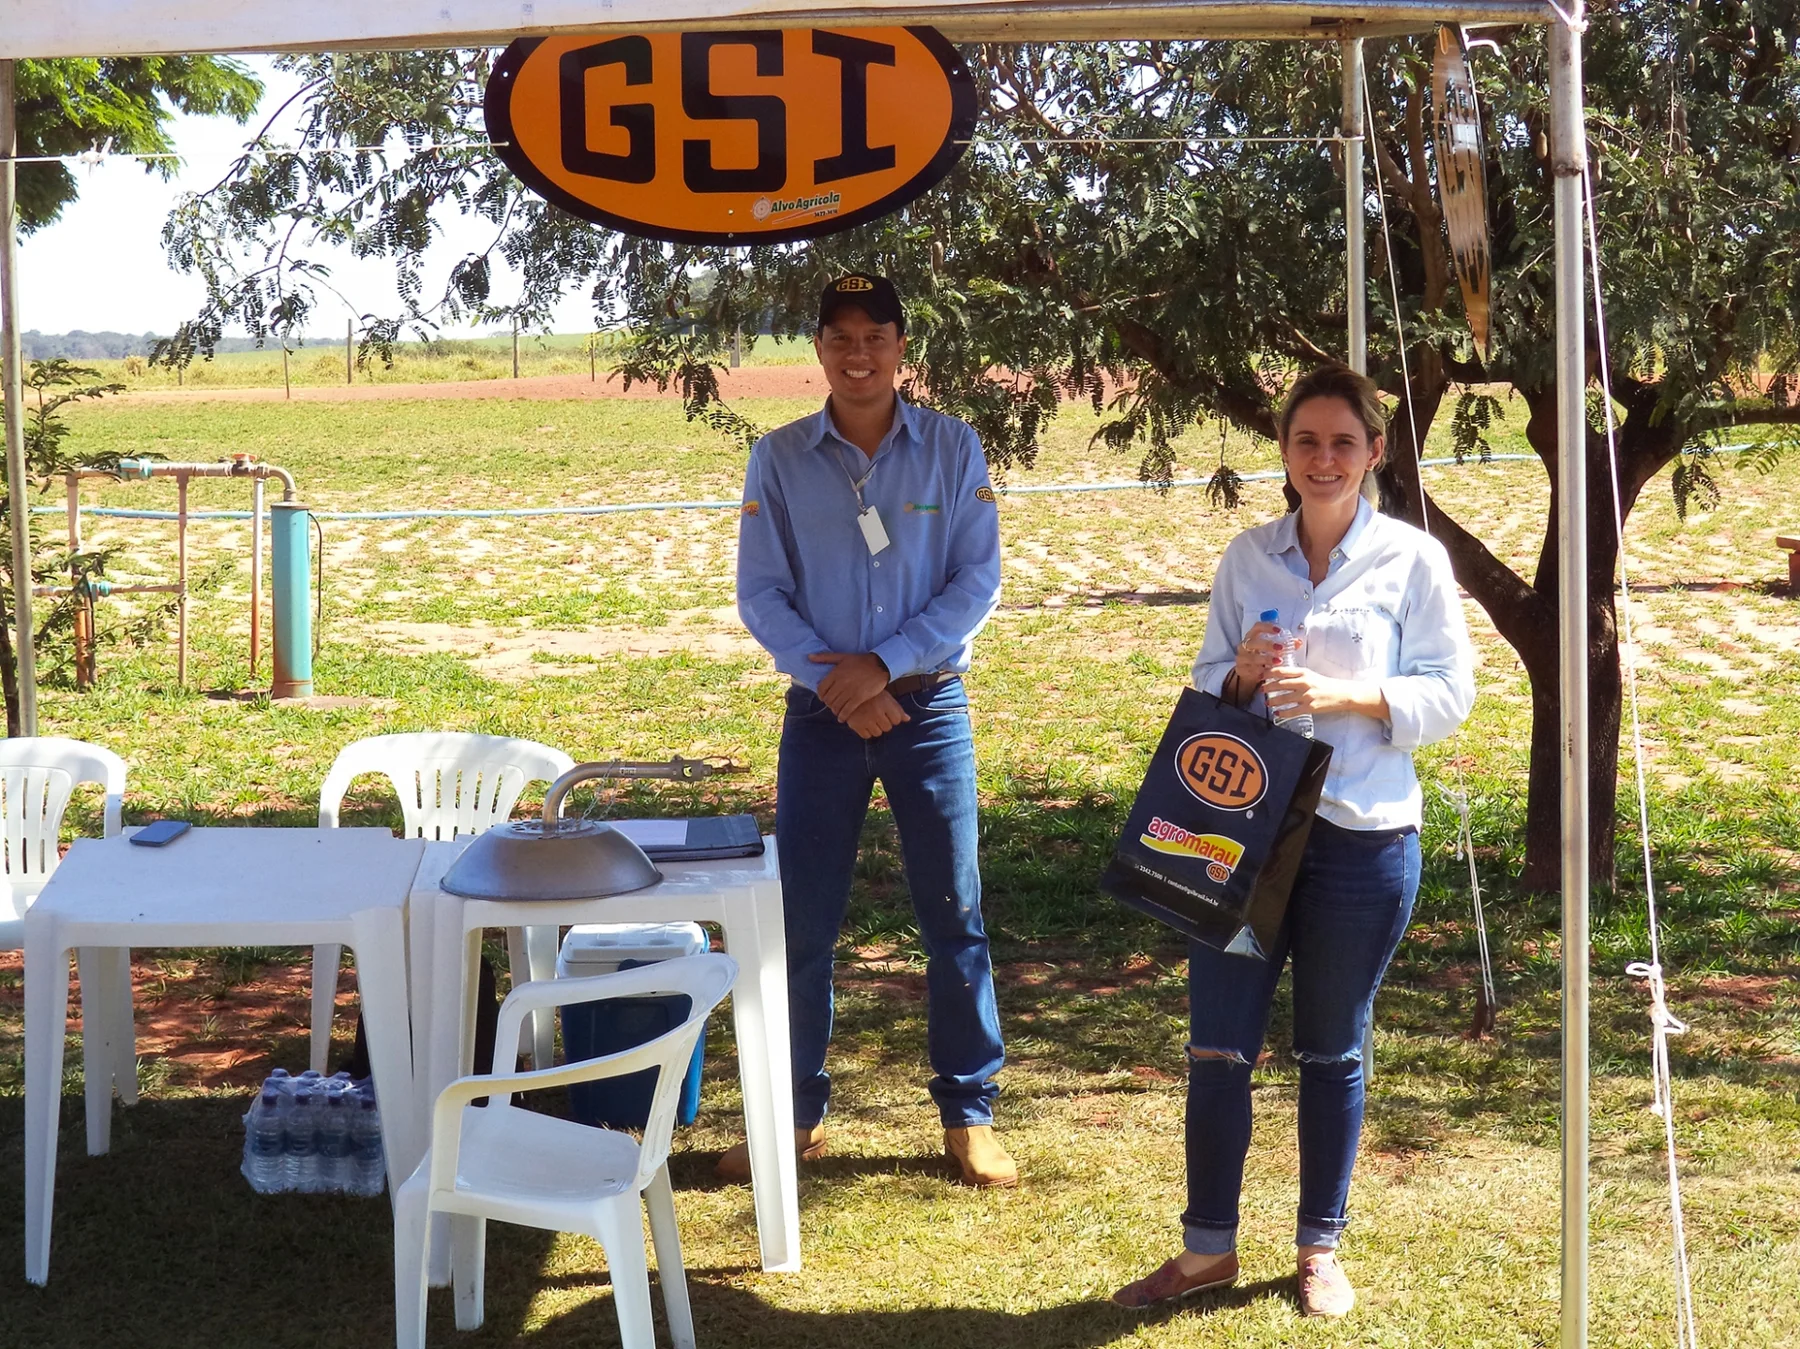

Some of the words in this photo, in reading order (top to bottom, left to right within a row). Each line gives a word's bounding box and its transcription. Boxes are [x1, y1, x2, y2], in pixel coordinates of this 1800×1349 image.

[560, 29, 896, 193] GSI
[840, 279, 868, 290] GSI
[1187, 745, 1255, 799] GSI
[1148, 817, 1238, 867] agromarau
[1210, 866, 1225, 879] GSI
